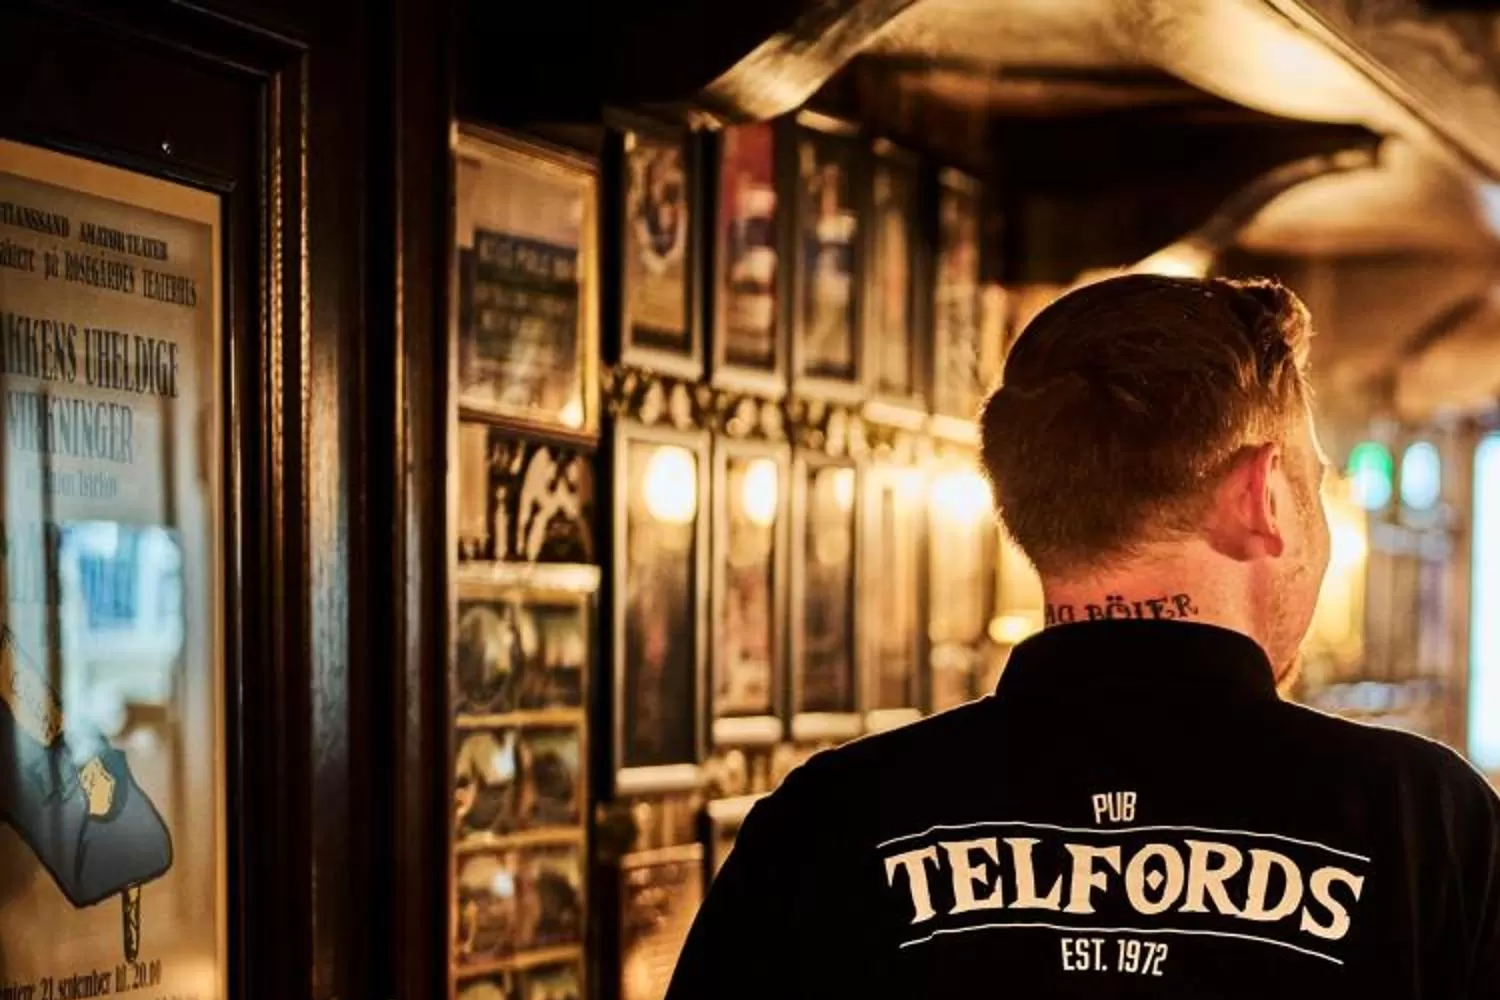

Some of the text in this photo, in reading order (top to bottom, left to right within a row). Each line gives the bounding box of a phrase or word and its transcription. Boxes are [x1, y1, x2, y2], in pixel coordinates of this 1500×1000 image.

[0, 311, 179, 399] KKENS UHELDIGE
[1092, 792, 1136, 824] PUB
[884, 837, 1365, 940] TELFORDS
[1060, 938, 1168, 976] EST. 1972
